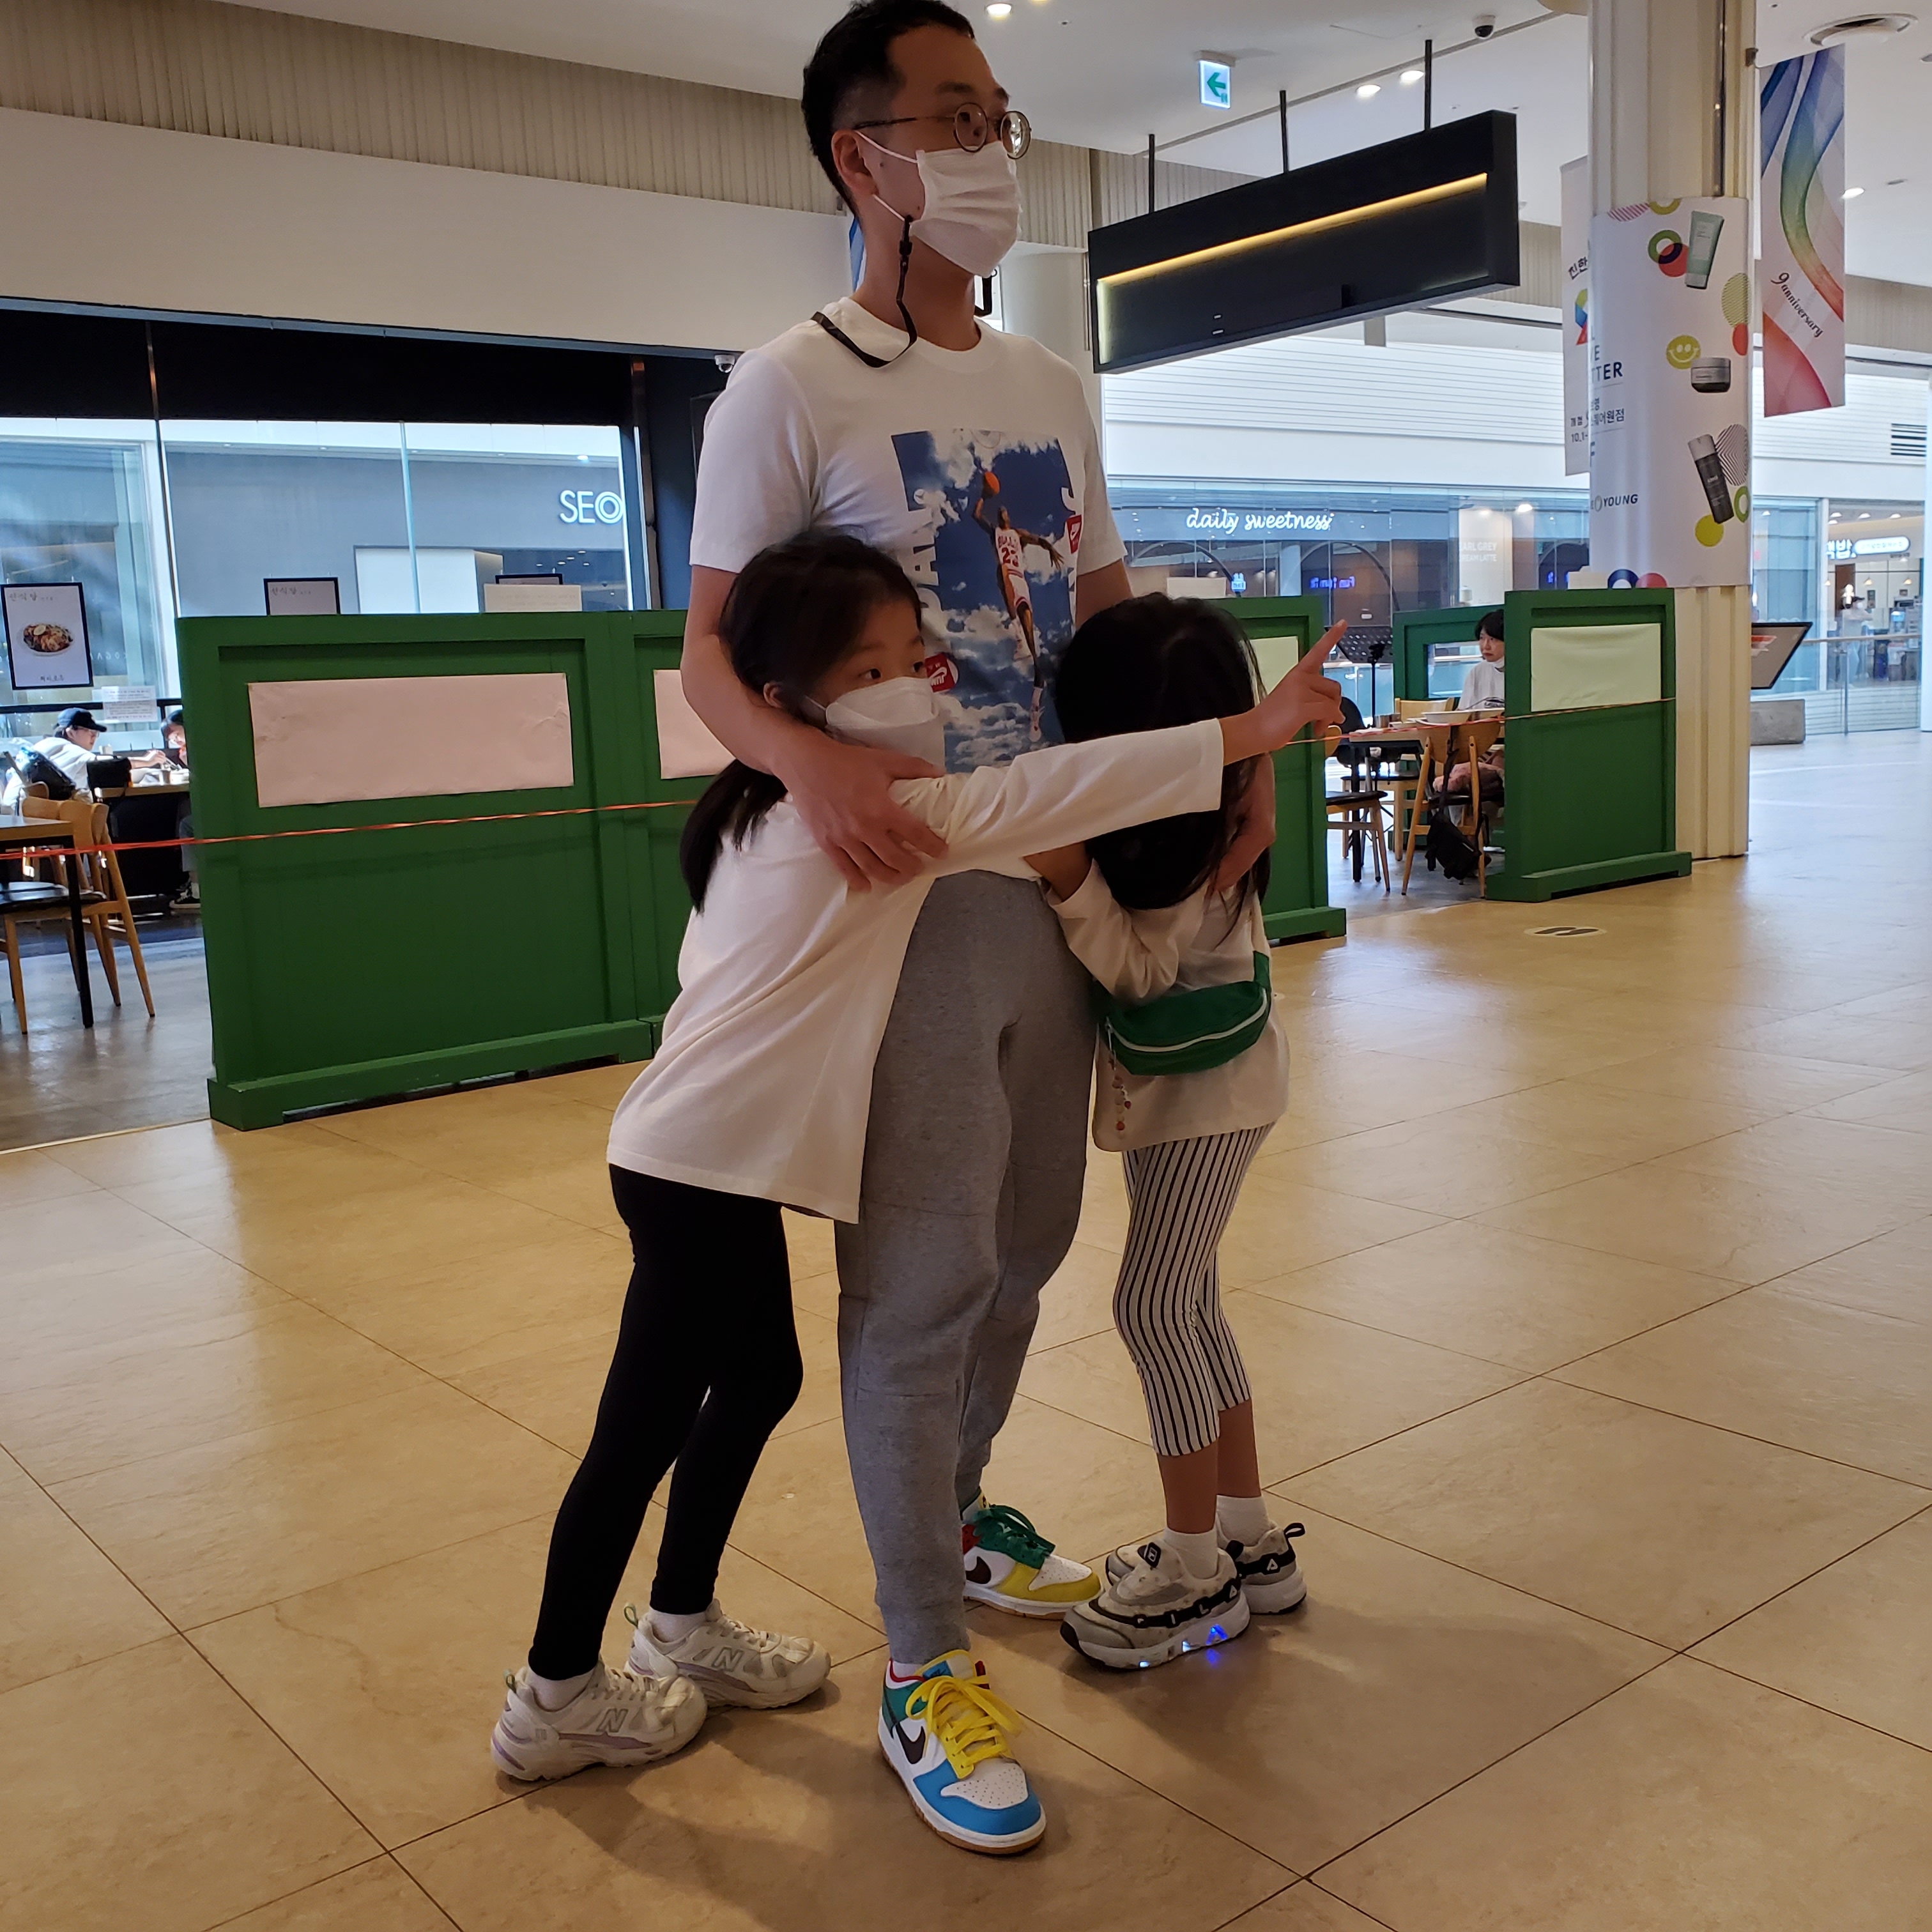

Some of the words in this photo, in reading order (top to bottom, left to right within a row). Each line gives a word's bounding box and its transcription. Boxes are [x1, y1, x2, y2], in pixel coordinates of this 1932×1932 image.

[1603, 494, 1638, 507] YOUNG
[1186, 507, 1239, 534] daily
[1245, 510, 1333, 531] sweetness
